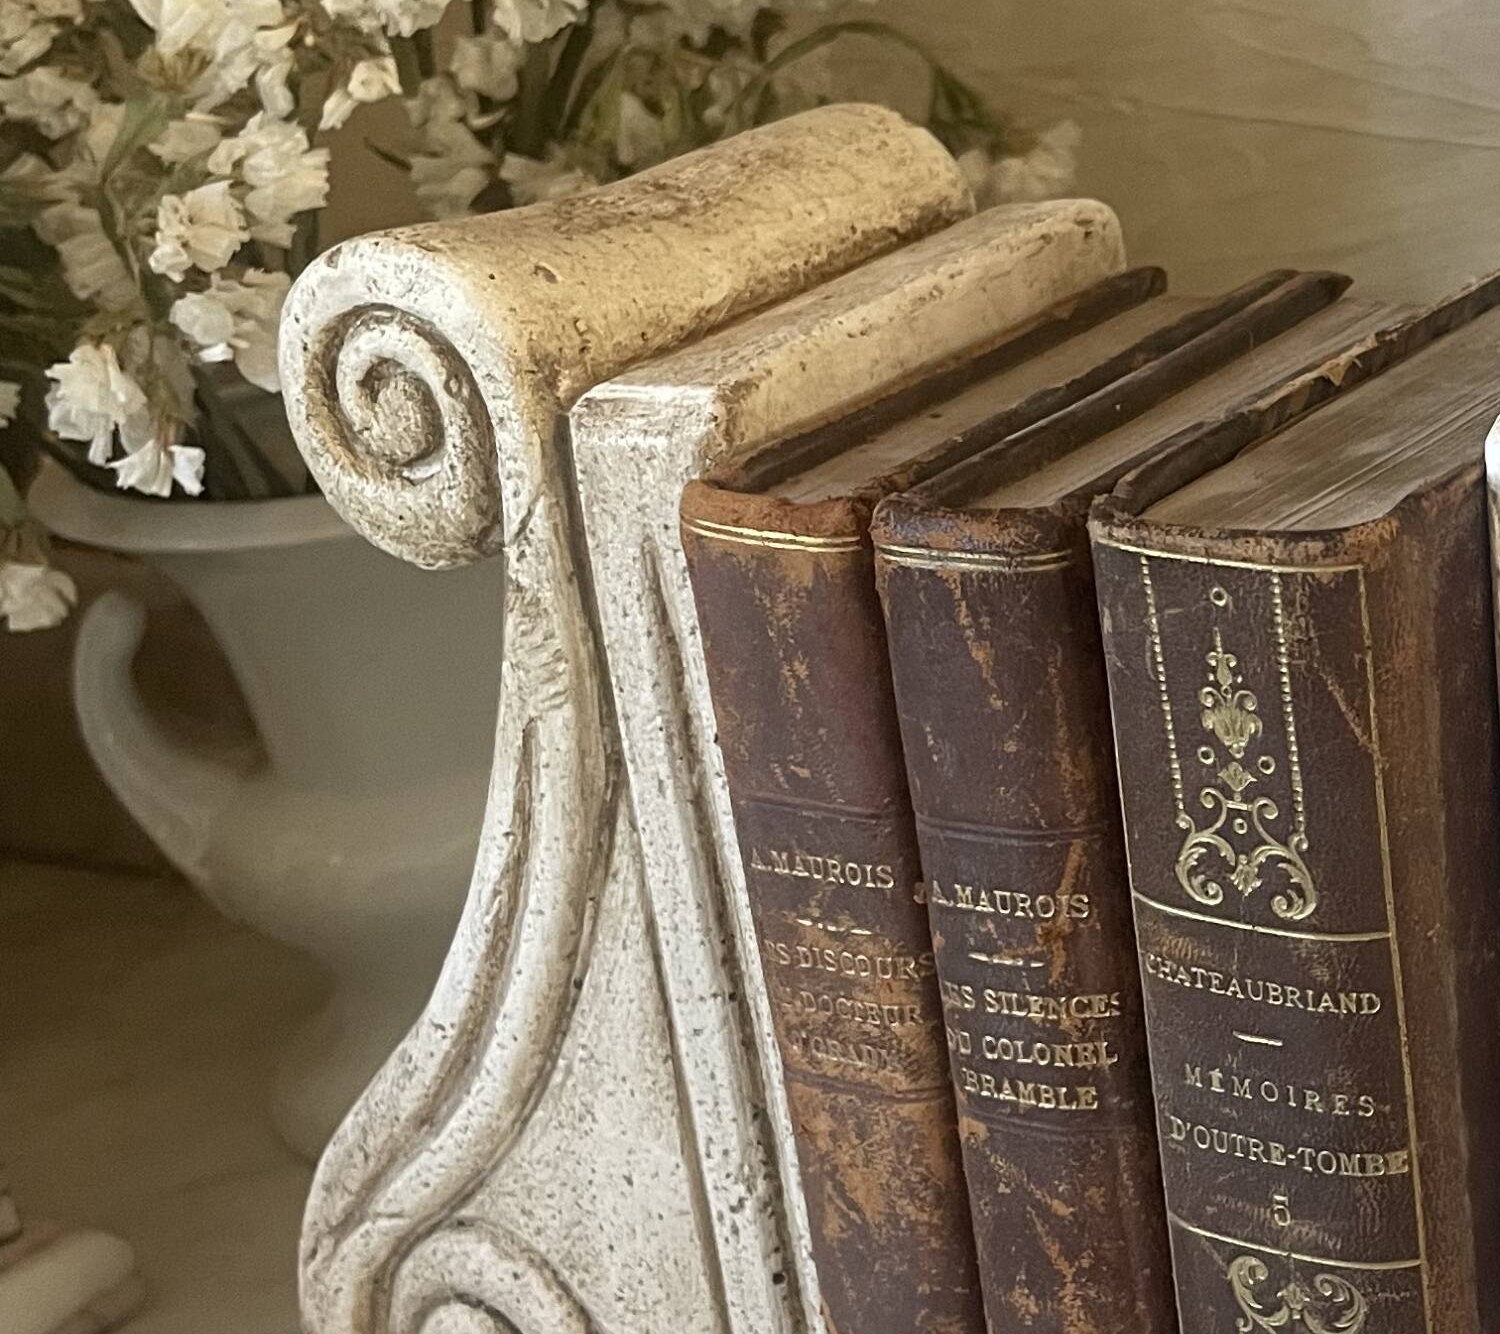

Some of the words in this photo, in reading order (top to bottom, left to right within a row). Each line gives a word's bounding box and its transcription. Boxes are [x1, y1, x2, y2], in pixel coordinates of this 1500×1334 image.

[1145, 953, 1382, 1015] CHATEAUBRIAND
[981, 1035, 1119, 1067] COLONEL
[960, 1067, 1099, 1110] BRAMBLE
[1169, 1115, 1410, 1177] D'OUTRE-TOMBE
[1271, 1194, 1292, 1227] 5
